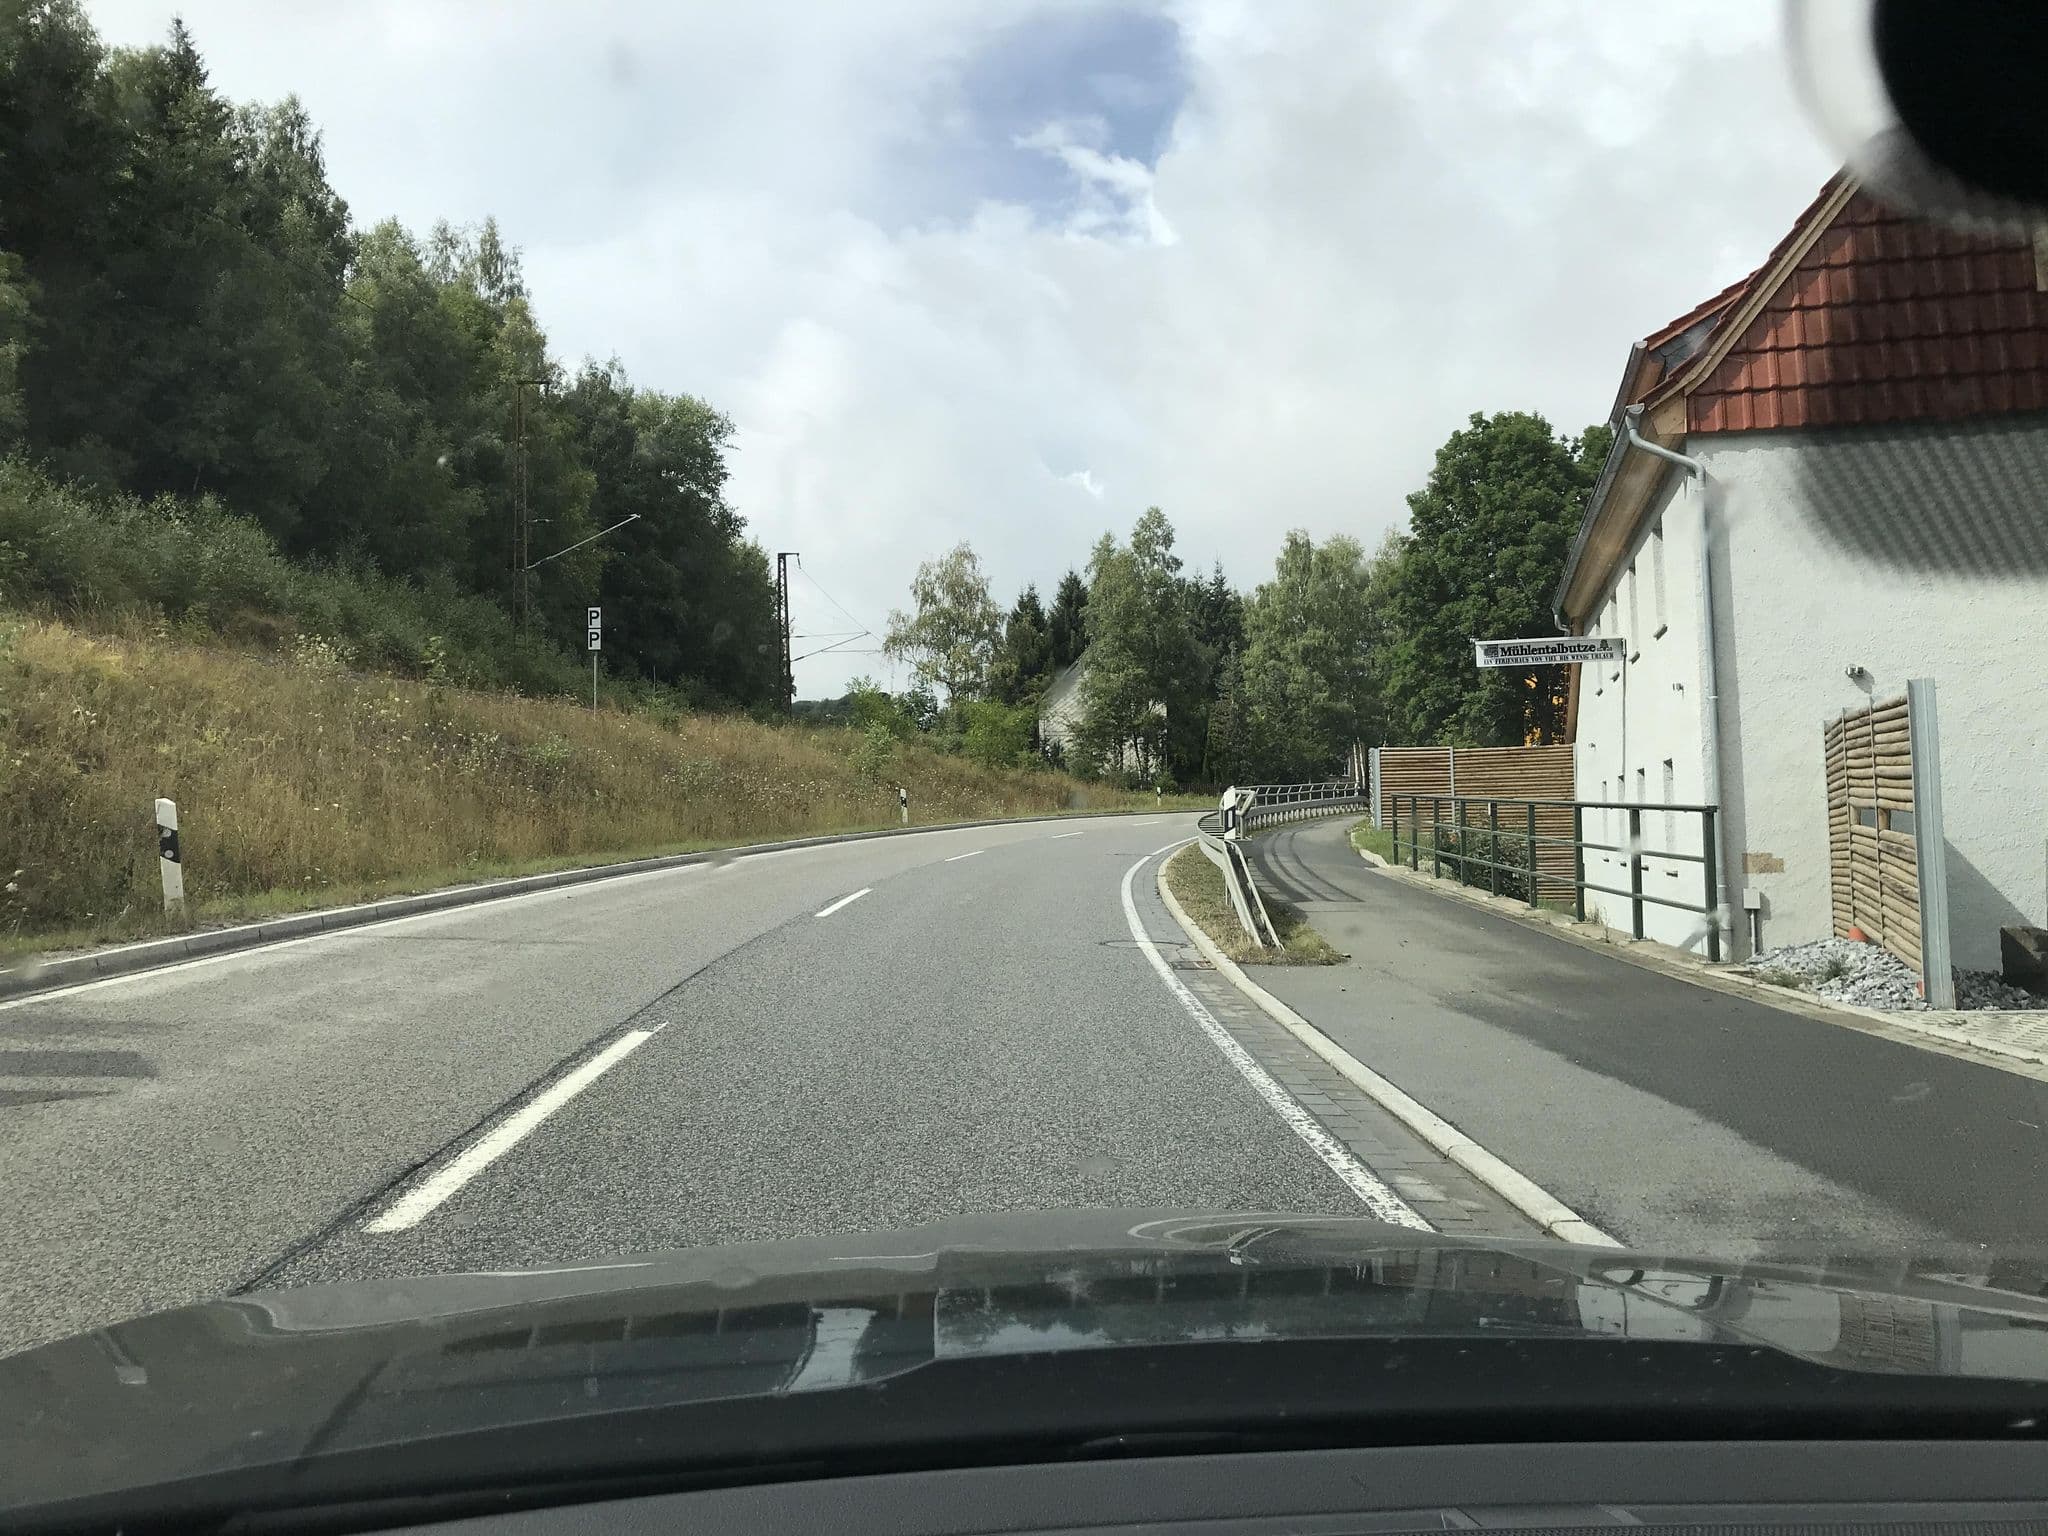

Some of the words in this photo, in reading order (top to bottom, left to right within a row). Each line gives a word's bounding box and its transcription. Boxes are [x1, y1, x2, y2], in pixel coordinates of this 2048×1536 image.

[590, 610, 599, 626] P
[590, 632, 599, 647] P
[1500, 643, 1596, 656] Mühlentalbutze
